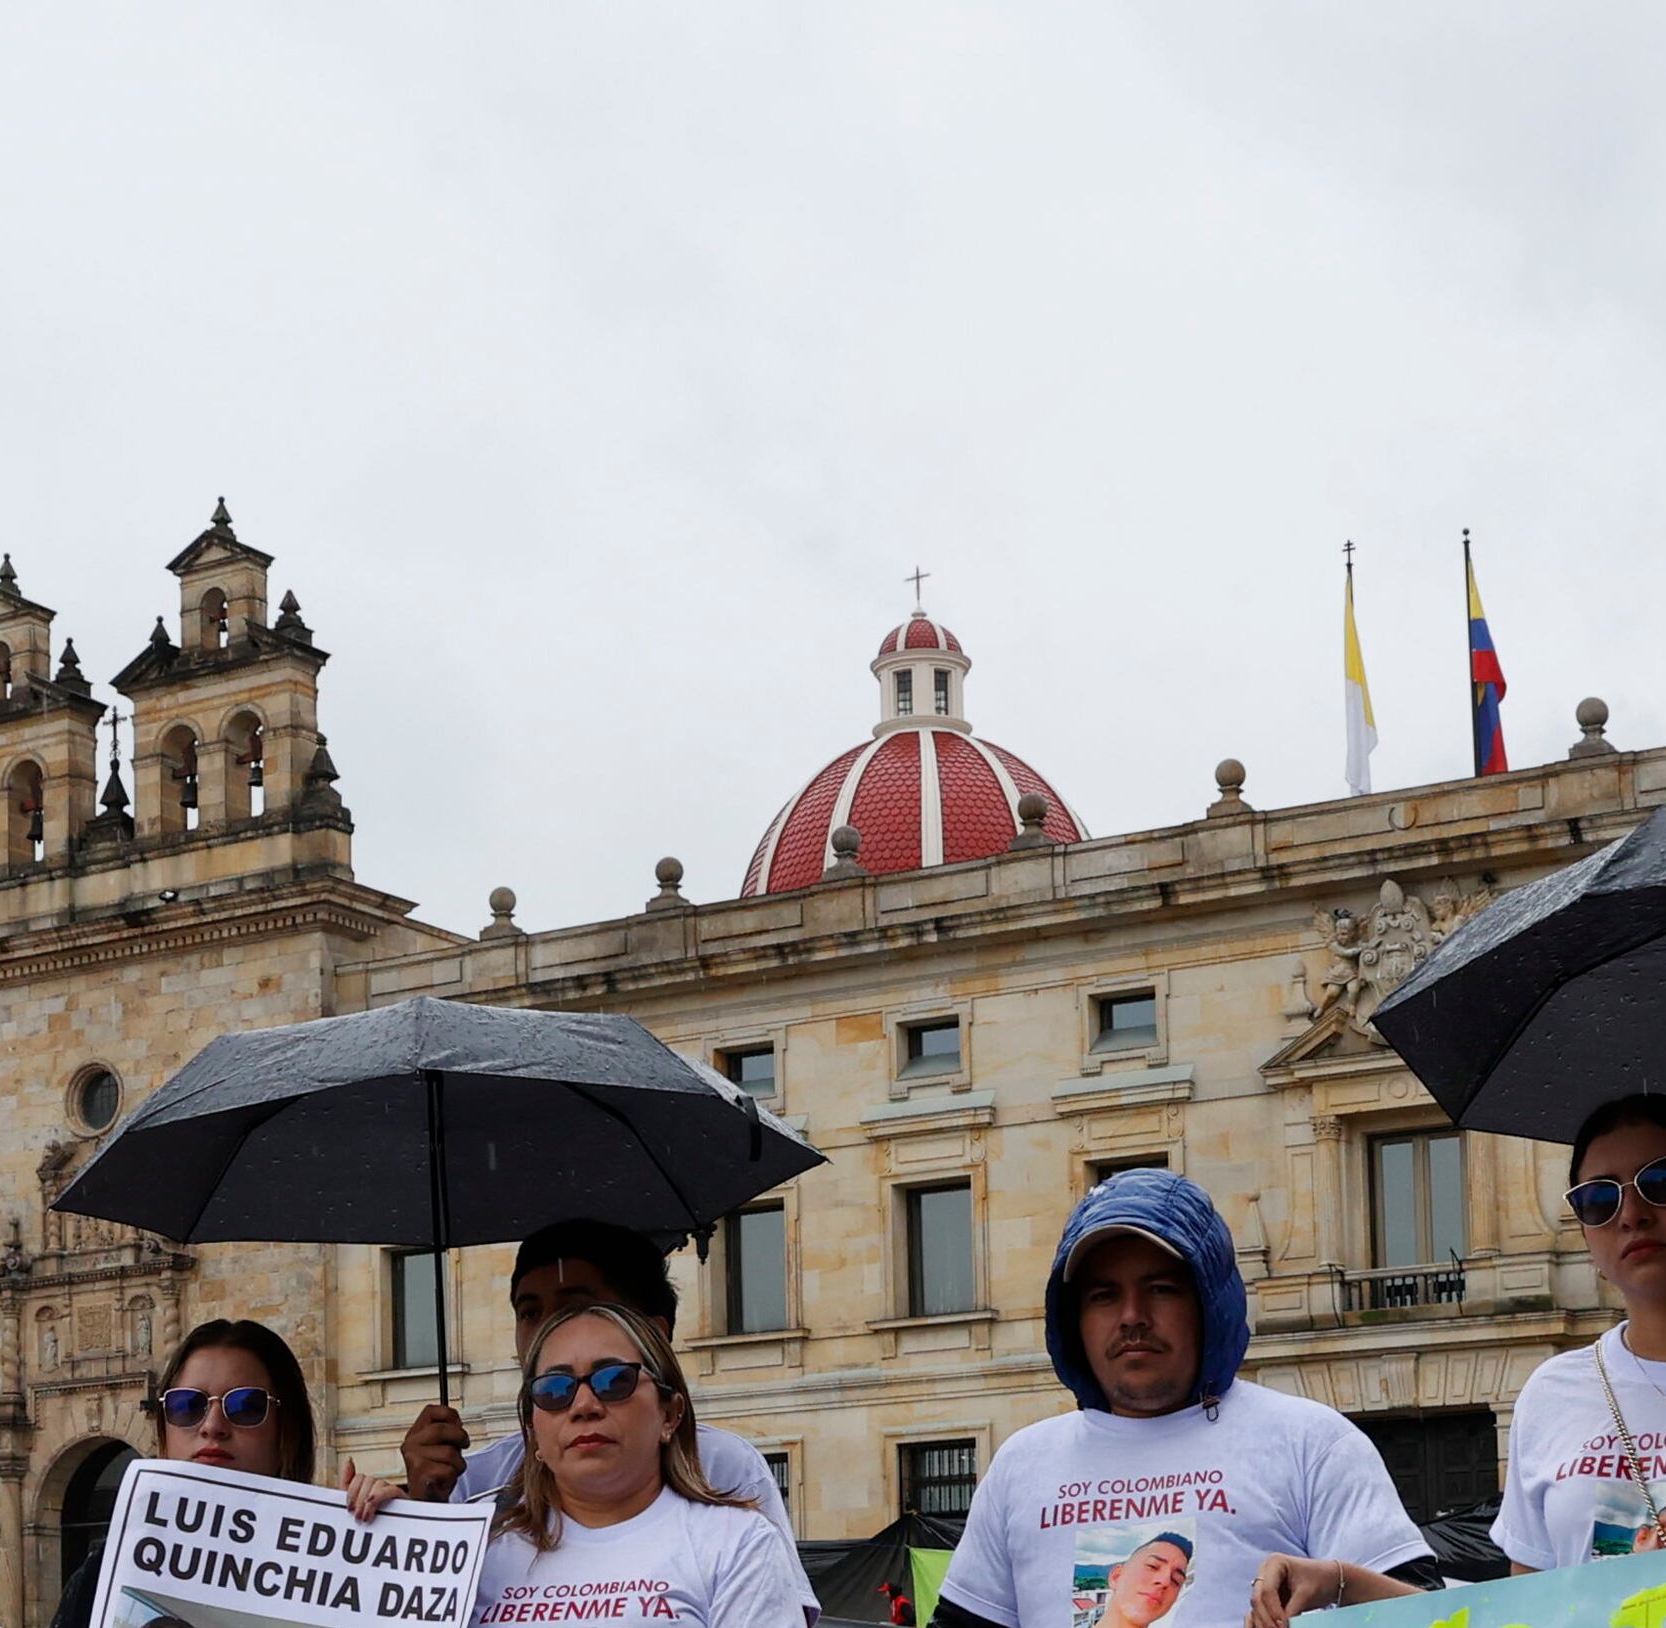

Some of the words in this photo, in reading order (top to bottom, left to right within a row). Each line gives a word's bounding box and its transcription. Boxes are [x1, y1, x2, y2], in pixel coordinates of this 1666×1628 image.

[1058, 1481, 1092, 1500] SOY
[1097, 1469, 1223, 1495] COLOMBIANO
[1040, 1493, 1182, 1529] LIBERENME
[1192, 1488, 1237, 1515] YA.
[144, 1491, 258, 1544] LUIS
[276, 1516, 469, 1575] EDUARDO
[132, 1536, 361, 1612] QUINCHIA
[376, 1583, 458, 1622] DAZA
[502, 1585, 540, 1600] SOY
[543, 1579, 670, 1598] COLOMBIANO
[479, 1597, 629, 1624] LIBERENME
[637, 1596, 681, 1620] YA.
